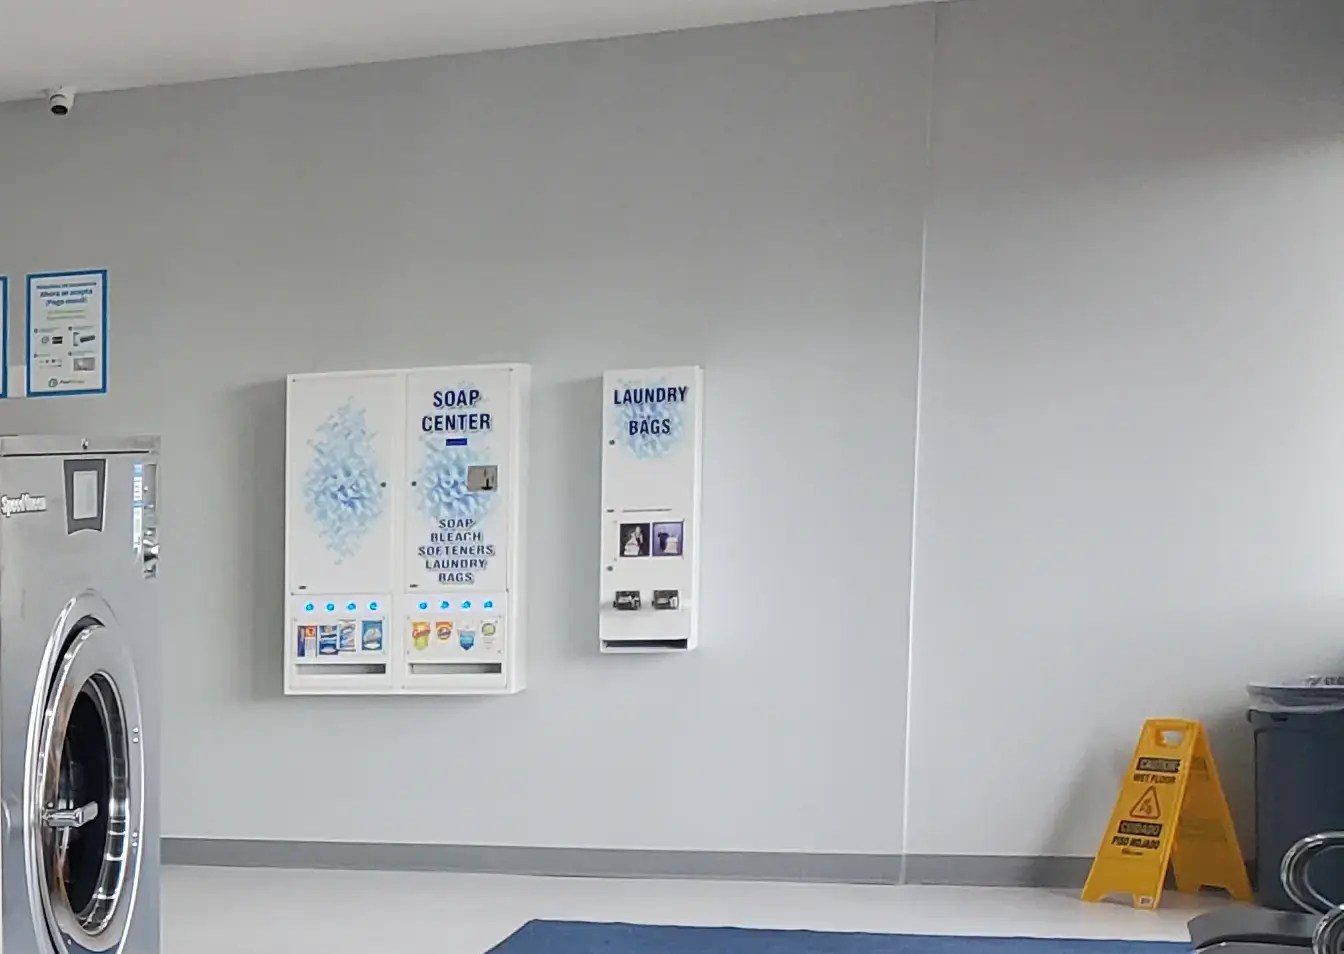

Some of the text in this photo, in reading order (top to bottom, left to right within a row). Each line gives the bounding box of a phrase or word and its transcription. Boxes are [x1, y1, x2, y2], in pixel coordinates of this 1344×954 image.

[432, 389, 481, 408] SOAP
[613, 385, 688, 405] LAUNDRY
[421, 413, 491, 432] CENTER
[628, 418, 671, 436] BAGS
[438, 518, 474, 529] SOAP
[430, 531, 481, 542] BLEACH
[417, 545, 494, 556] SOFTENERS
[425, 558, 486, 569] LAUNDRY
[438, 572, 474, 582] BAGS
